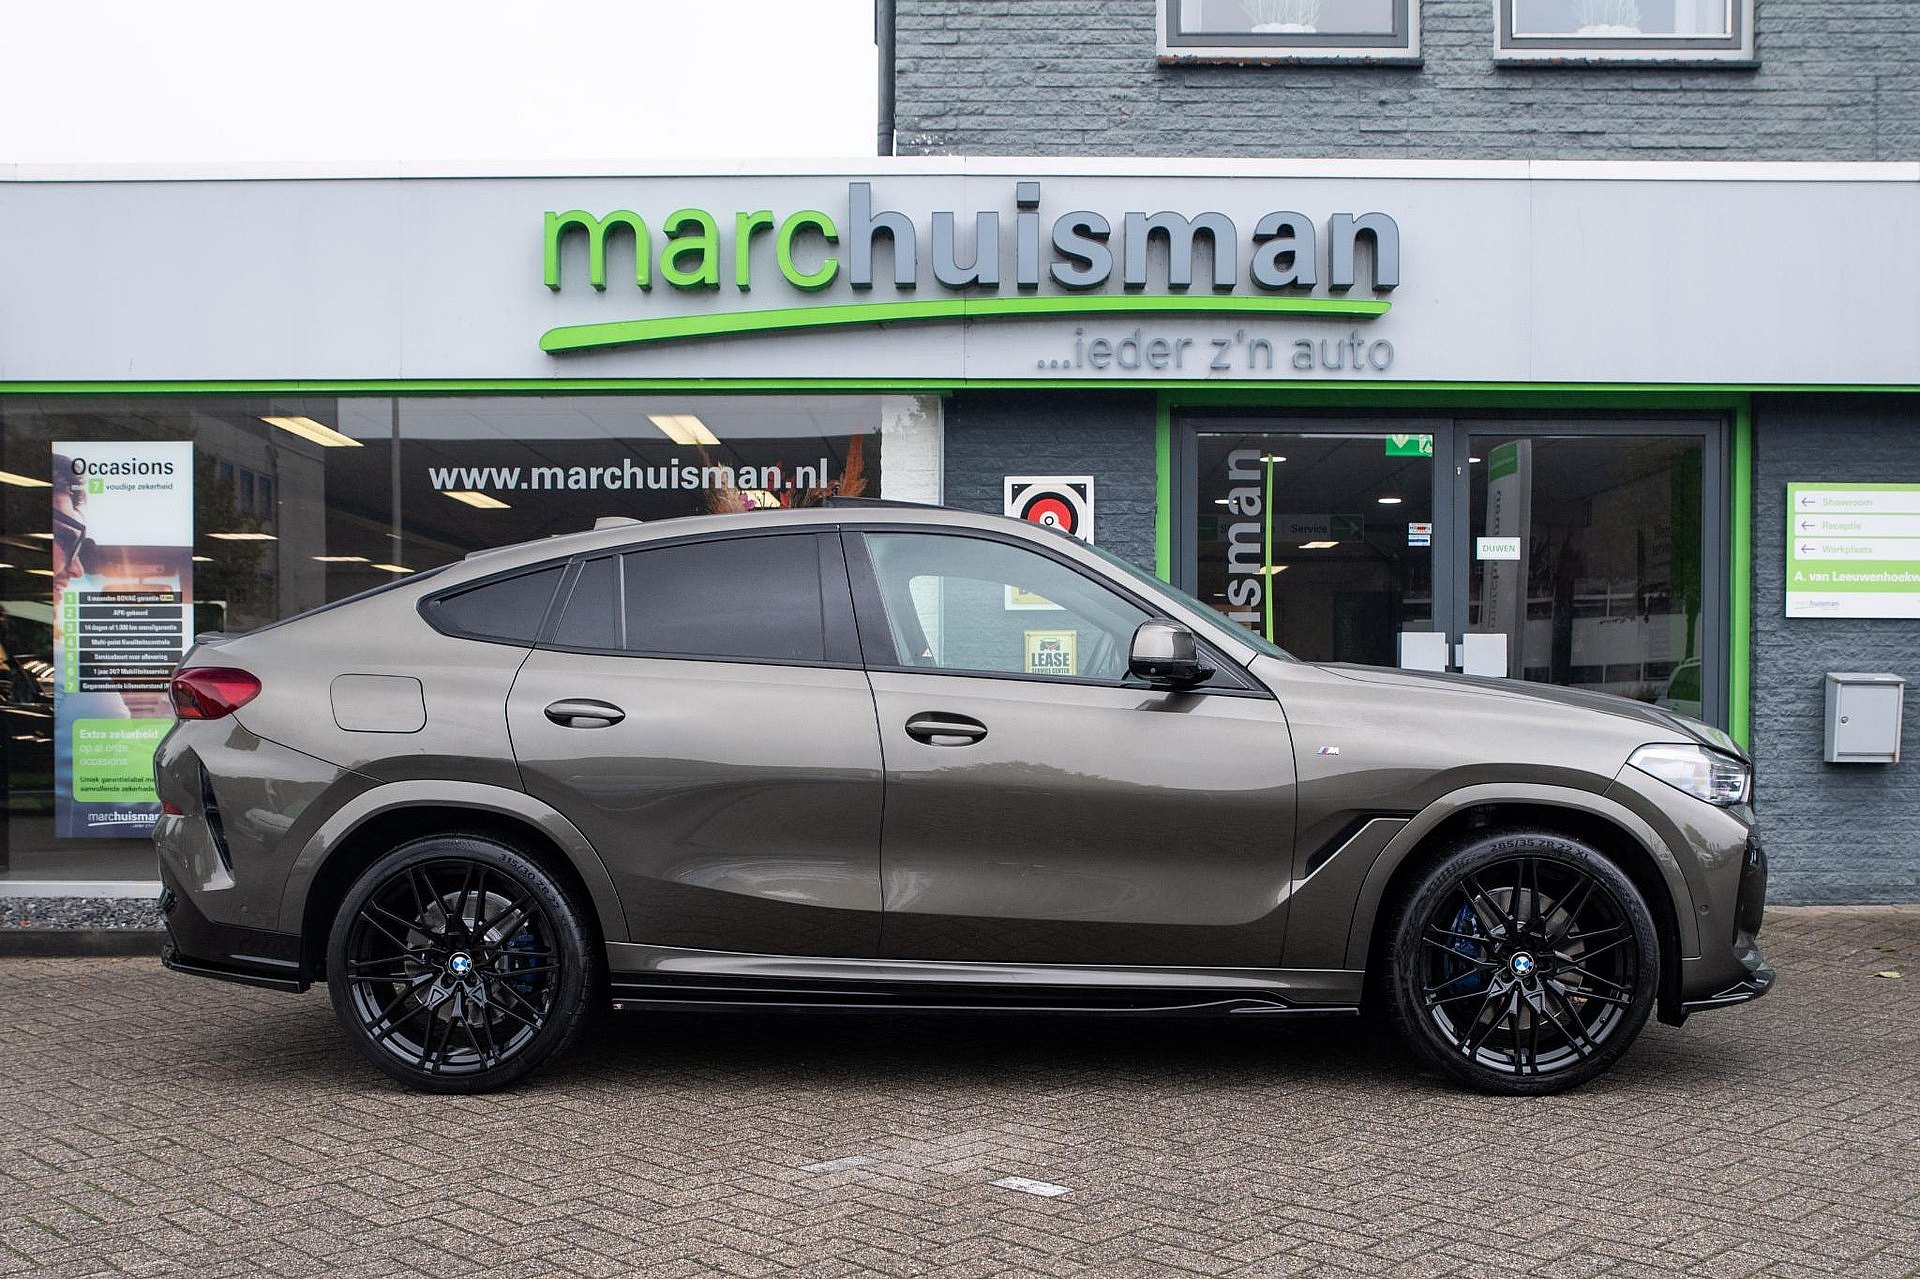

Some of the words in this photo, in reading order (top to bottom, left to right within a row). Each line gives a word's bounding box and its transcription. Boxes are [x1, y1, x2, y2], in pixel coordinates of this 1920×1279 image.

[543, 182, 1400, 292] marchuisman
[1210, 328, 1273, 369] z'n
[1292, 328, 1394, 370] auto
[71, 457, 174, 475] Occasions
[428, 458, 828, 490] www.marchuisman.nl
[106, 483, 136, 491] voudige
[138, 482, 173, 490] zekerheid
[1823, 498, 1873, 506] Showroom
[1291, 524, 1327, 533] Service
[1823, 521, 1861, 531] Receptie
[1483, 544, 1515, 552] DUWEN
[1823, 545, 1873, 555] Werkplaats
[1795, 571, 1806, 581] A.
[1809, 573, 1829, 581] van
[1031, 653, 1070, 667] LEASE
[80, 730, 106, 739] Extra
[110, 728, 158, 739] zekerheid
[80, 758, 128, 766] occasions
